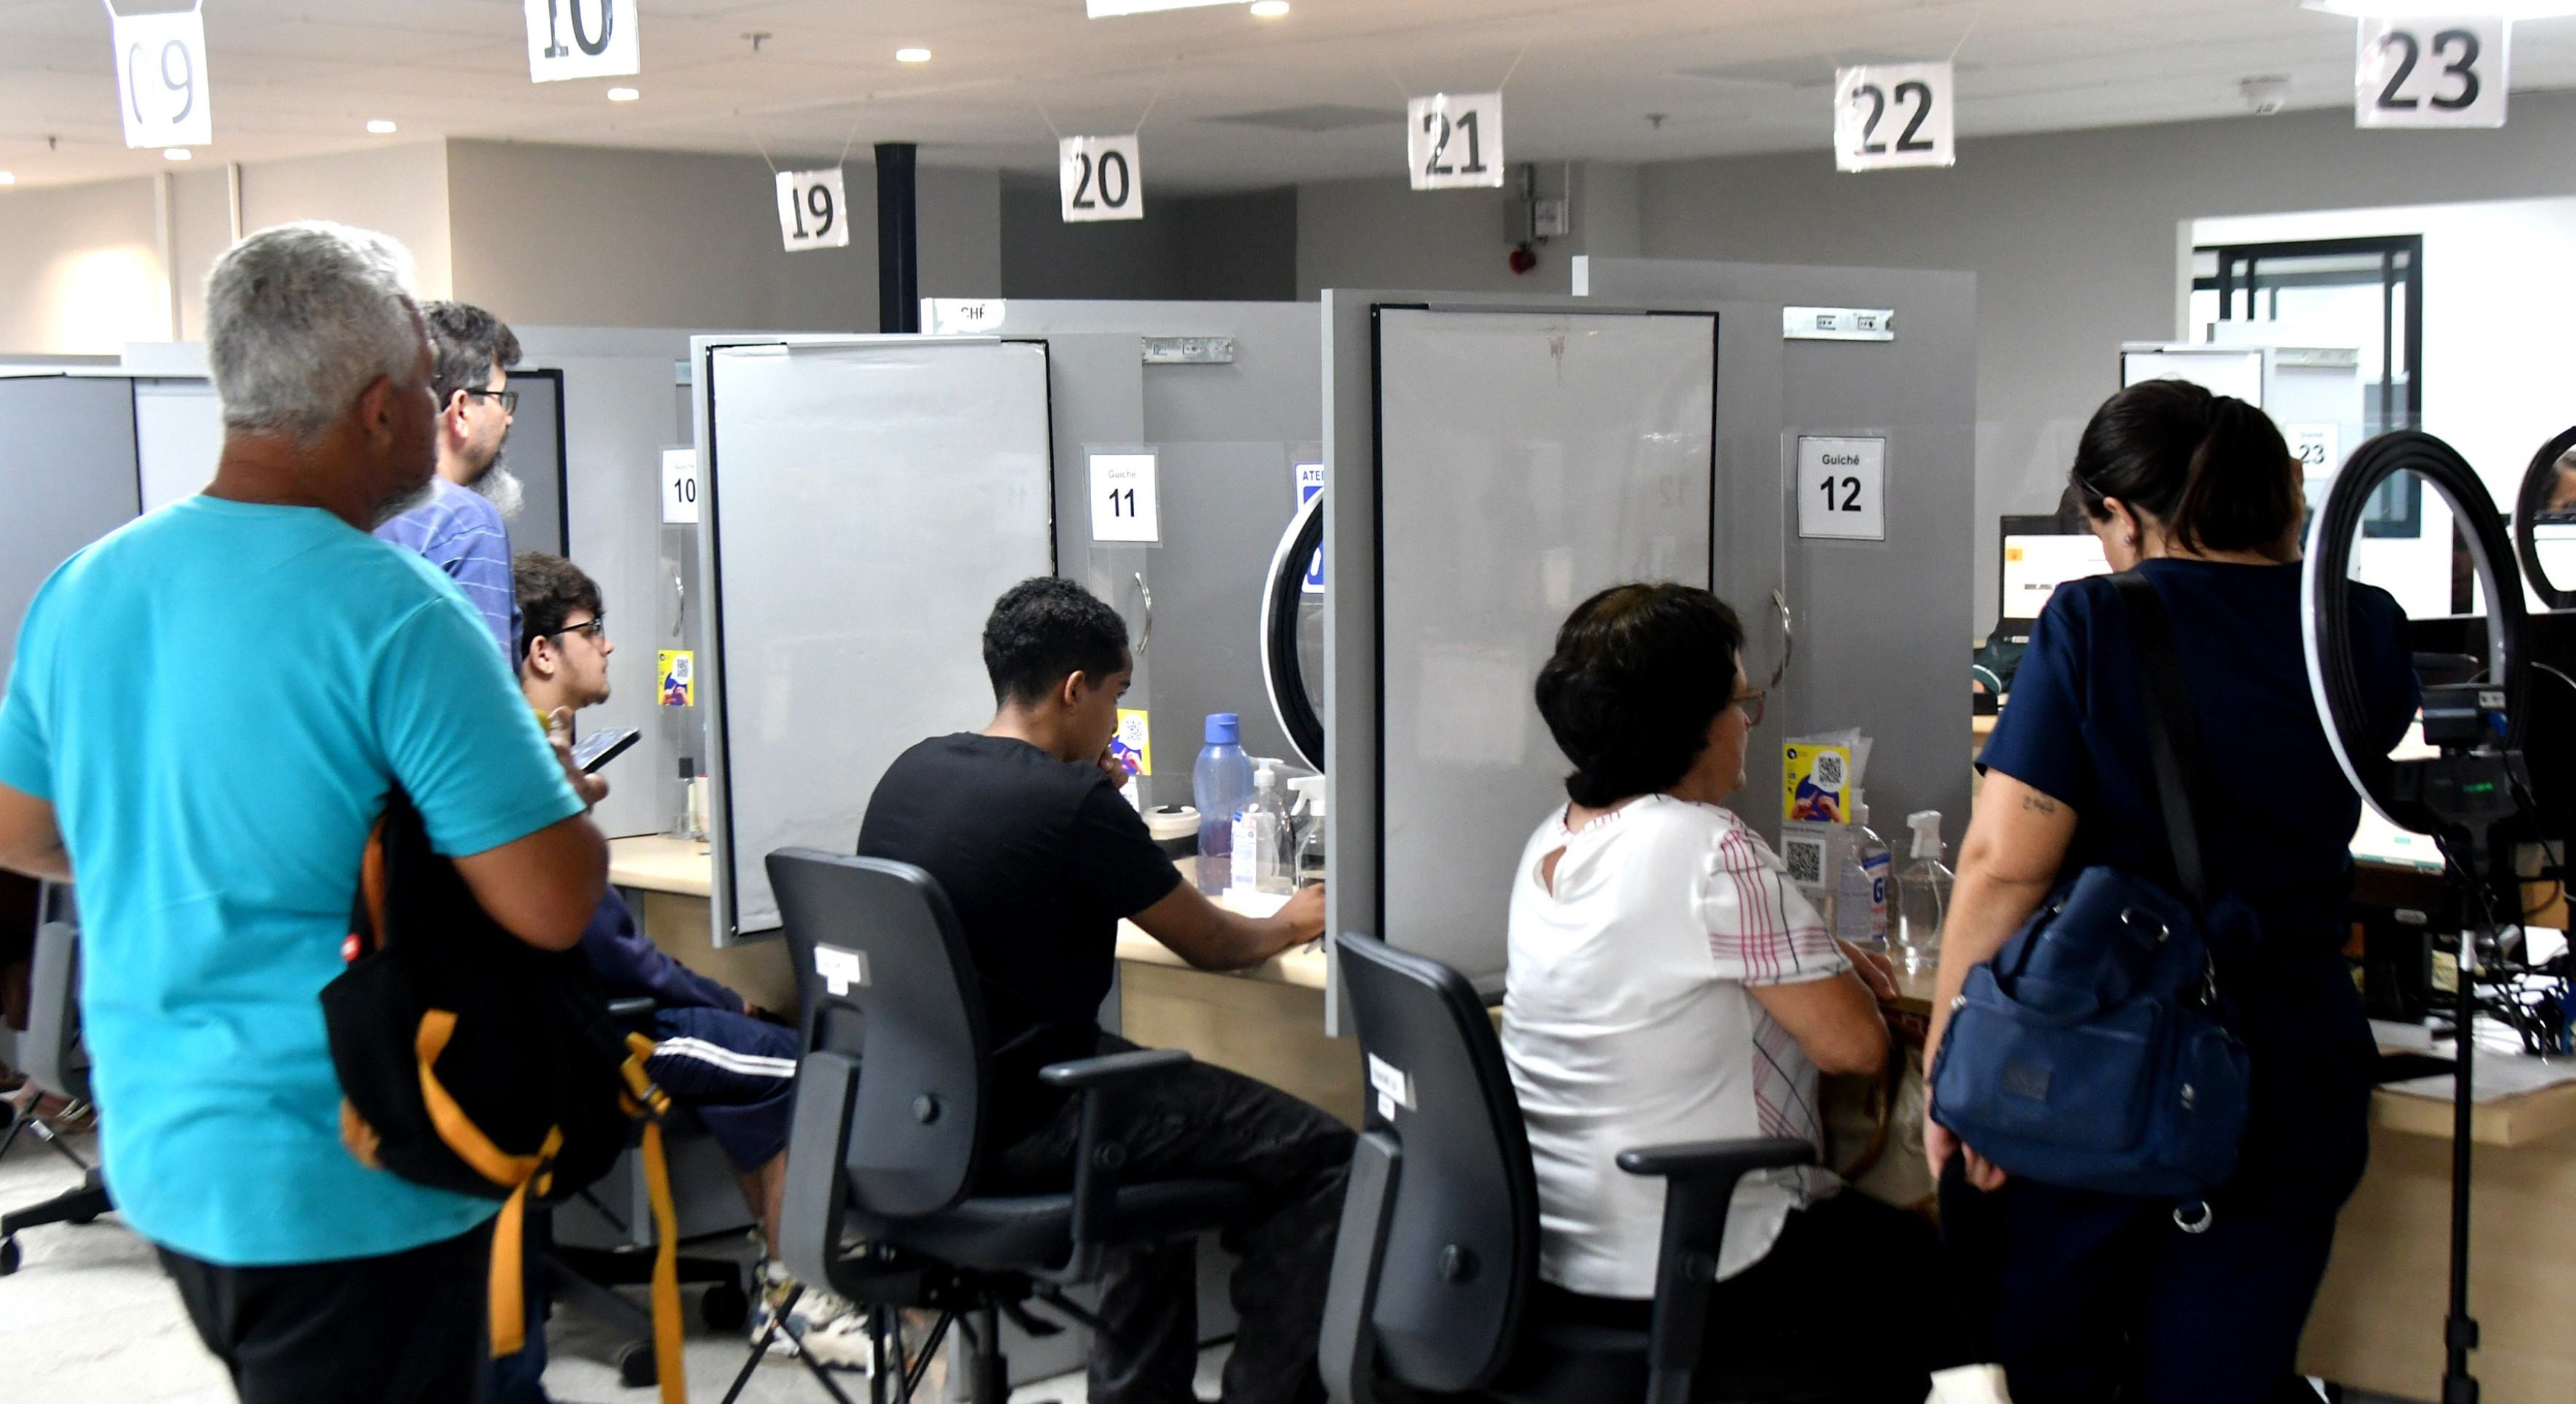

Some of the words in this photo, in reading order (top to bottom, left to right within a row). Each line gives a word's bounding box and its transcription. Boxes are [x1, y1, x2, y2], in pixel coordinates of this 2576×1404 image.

[2376, 29, 2481, 112] 23
[1853, 81, 1934, 156] 22
[1424, 109, 1487, 176] 21
[1071, 150, 1130, 209] 20
[793, 184, 834, 238] 19
[1303, 470, 1324, 481] ATE
[2299, 443, 2325, 465] 23
[674, 478, 697, 503] 10
[1109, 488, 1136, 518] 11
[1820, 476, 1862, 512] 12
